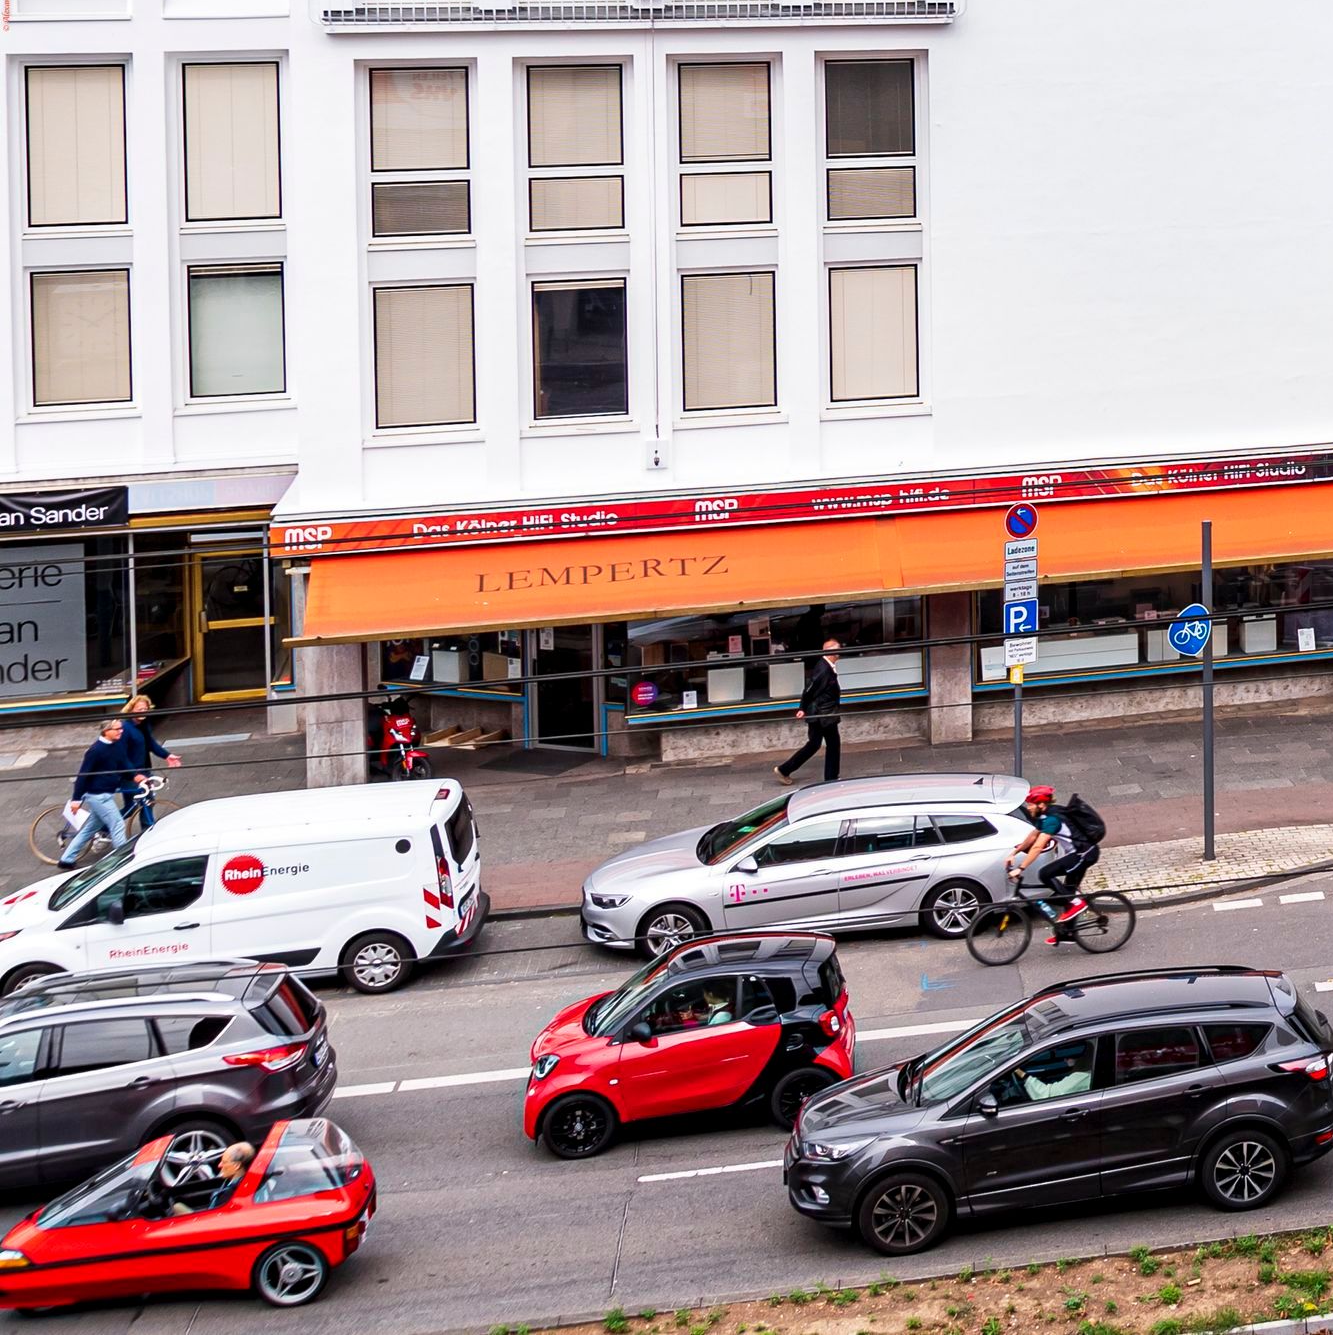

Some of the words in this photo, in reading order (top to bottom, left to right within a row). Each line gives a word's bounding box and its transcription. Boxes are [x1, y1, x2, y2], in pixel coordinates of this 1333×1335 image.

[30, 504, 109, 524] Sander
[412, 523, 450, 539] Das
[456, 519, 516, 536] Kölner
[1007, 545, 1035, 555] Ladezone
[474, 555, 729, 593] LEMPERTZ
[1010, 606, 1028, 634] P
[0, 653, 69, 684] der
[109, 942, 189, 960] RheinEnergie
